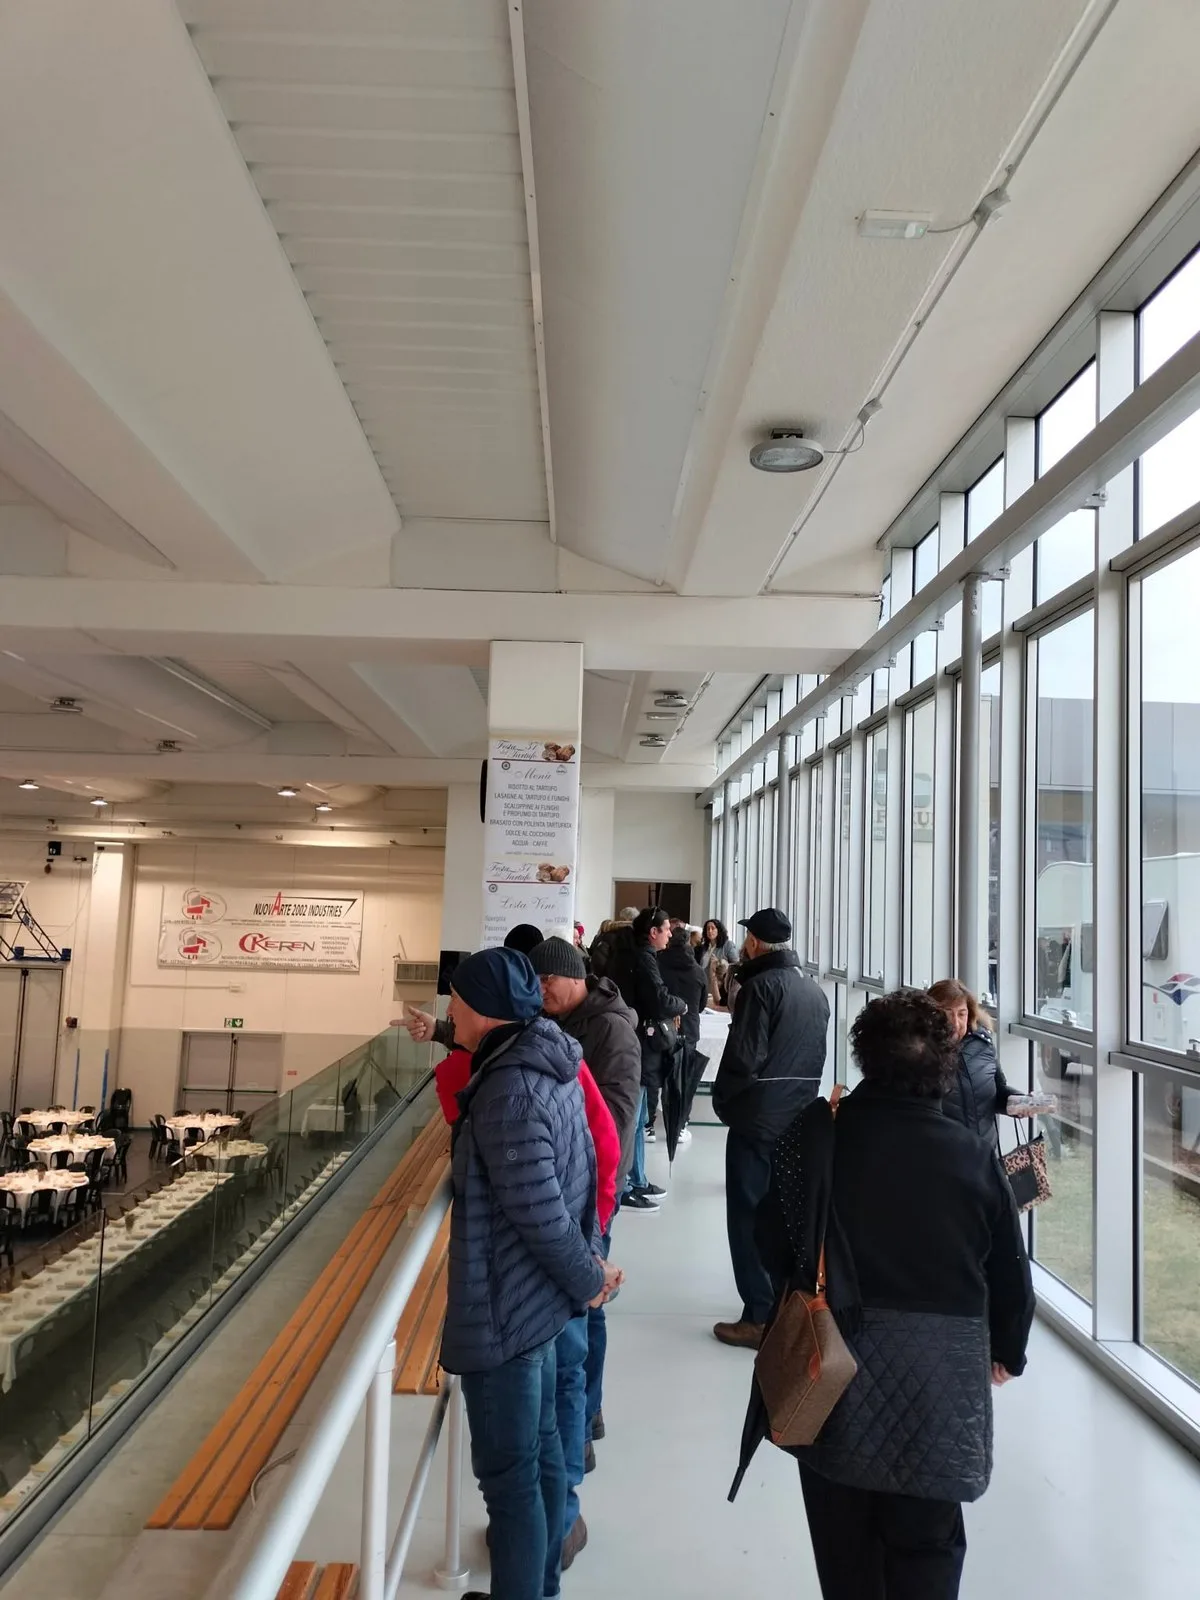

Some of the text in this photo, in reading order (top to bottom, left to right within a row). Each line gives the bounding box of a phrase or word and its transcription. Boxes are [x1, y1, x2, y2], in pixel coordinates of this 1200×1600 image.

[500, 895, 556, 910] Lista Vini
[292, 904, 308, 916] 2002
[308, 905, 342, 918] INDUSTRIES
